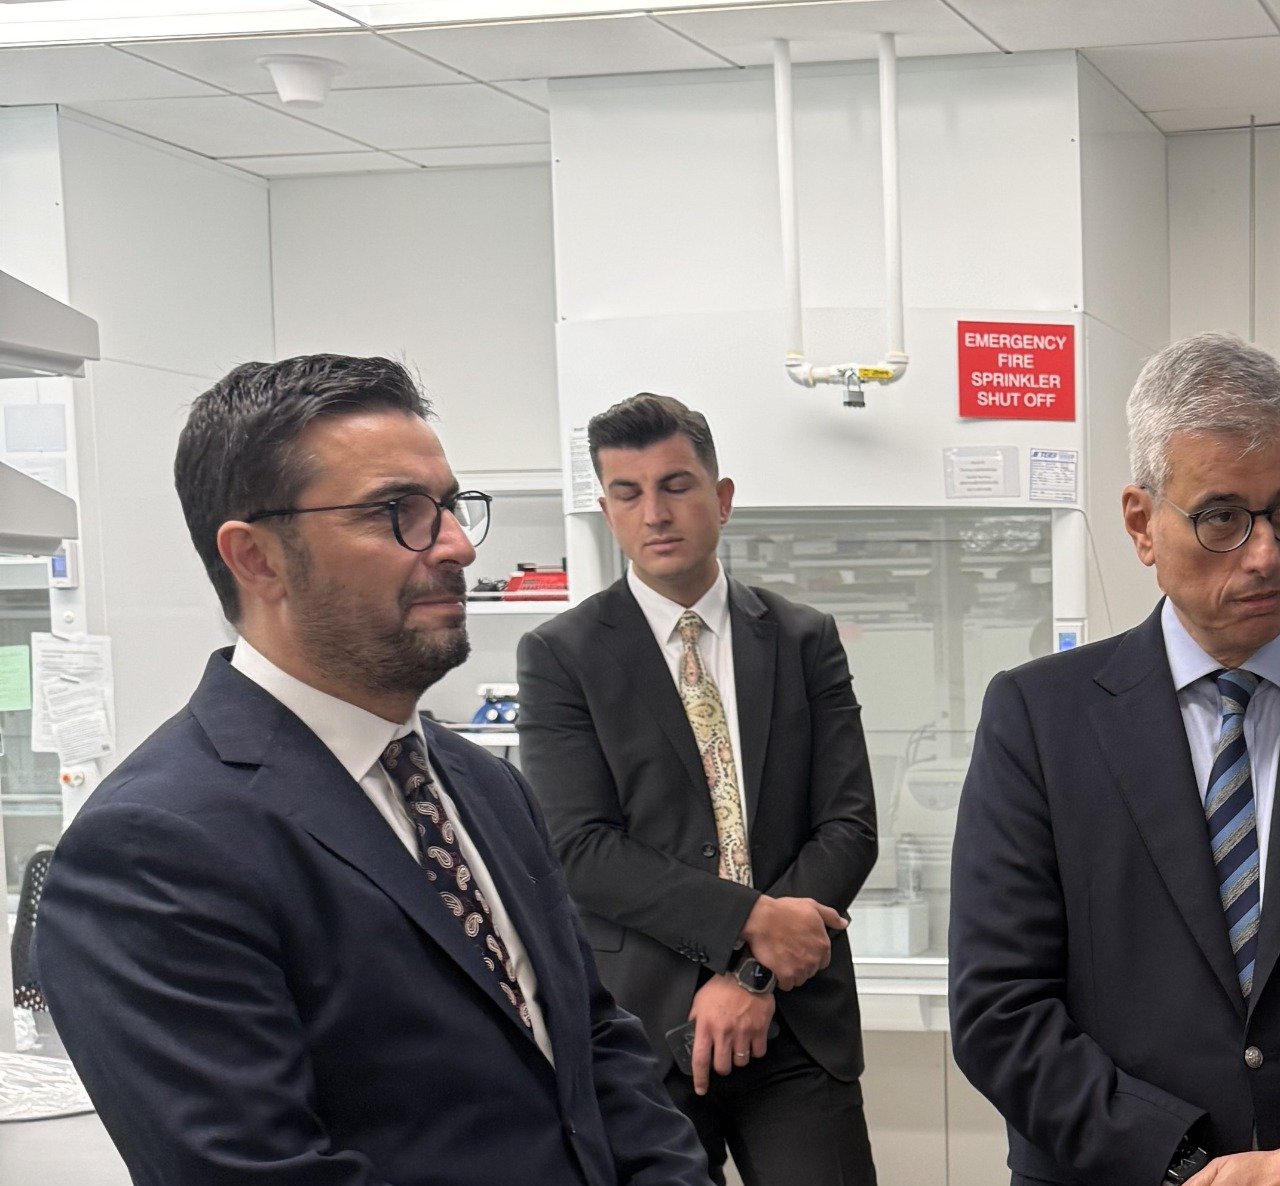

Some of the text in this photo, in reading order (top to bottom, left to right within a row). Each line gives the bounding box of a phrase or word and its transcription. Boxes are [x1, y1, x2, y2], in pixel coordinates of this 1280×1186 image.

[964, 332, 1067, 350] EMERGENCY
[997, 353, 1034, 369] FIRE
[971, 371, 1061, 389] SPRINKLER
[977, 391, 1056, 408] SHUT OFF
